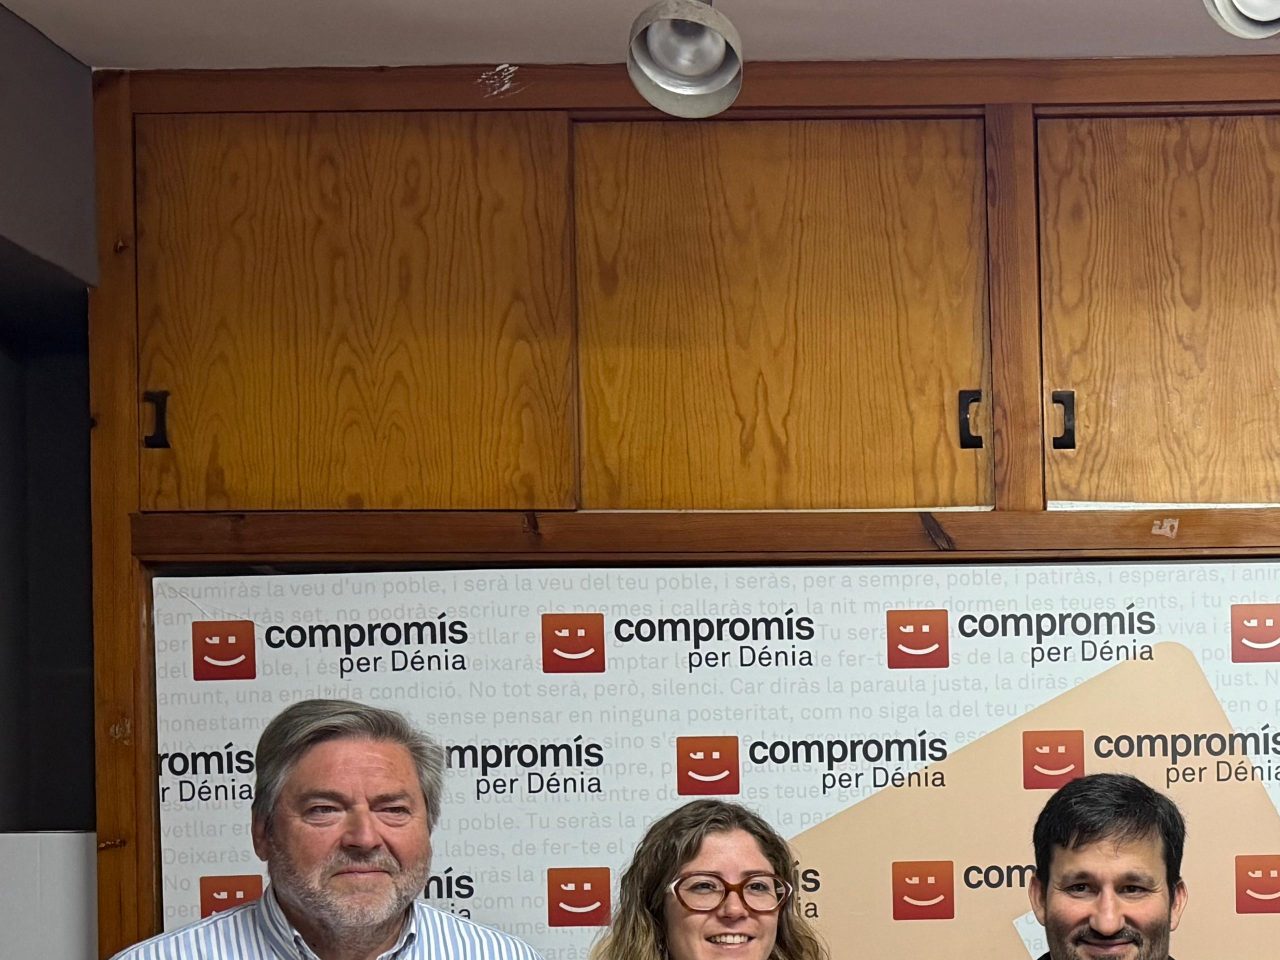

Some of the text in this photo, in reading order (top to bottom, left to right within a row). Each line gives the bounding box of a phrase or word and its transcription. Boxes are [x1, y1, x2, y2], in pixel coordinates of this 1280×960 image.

[265, 612, 468, 655] compromís
[615, 608, 814, 649] compromís
[959, 603, 1155, 644] compromís
[340, 649, 466, 678] per Dénia
[689, 645, 812, 673] per Dénia
[1032, 641, 1153, 667] per Dénia
[158, 742, 254, 776] romís
[446, 735, 604, 776] mpromís
[749, 730, 947, 770] compromís
[179, 779, 253, 802] Dénia
[477, 771, 602, 800] per Dénia
[823, 767, 945, 794] per Dénia
[1167, 767, 1206, 788] per
